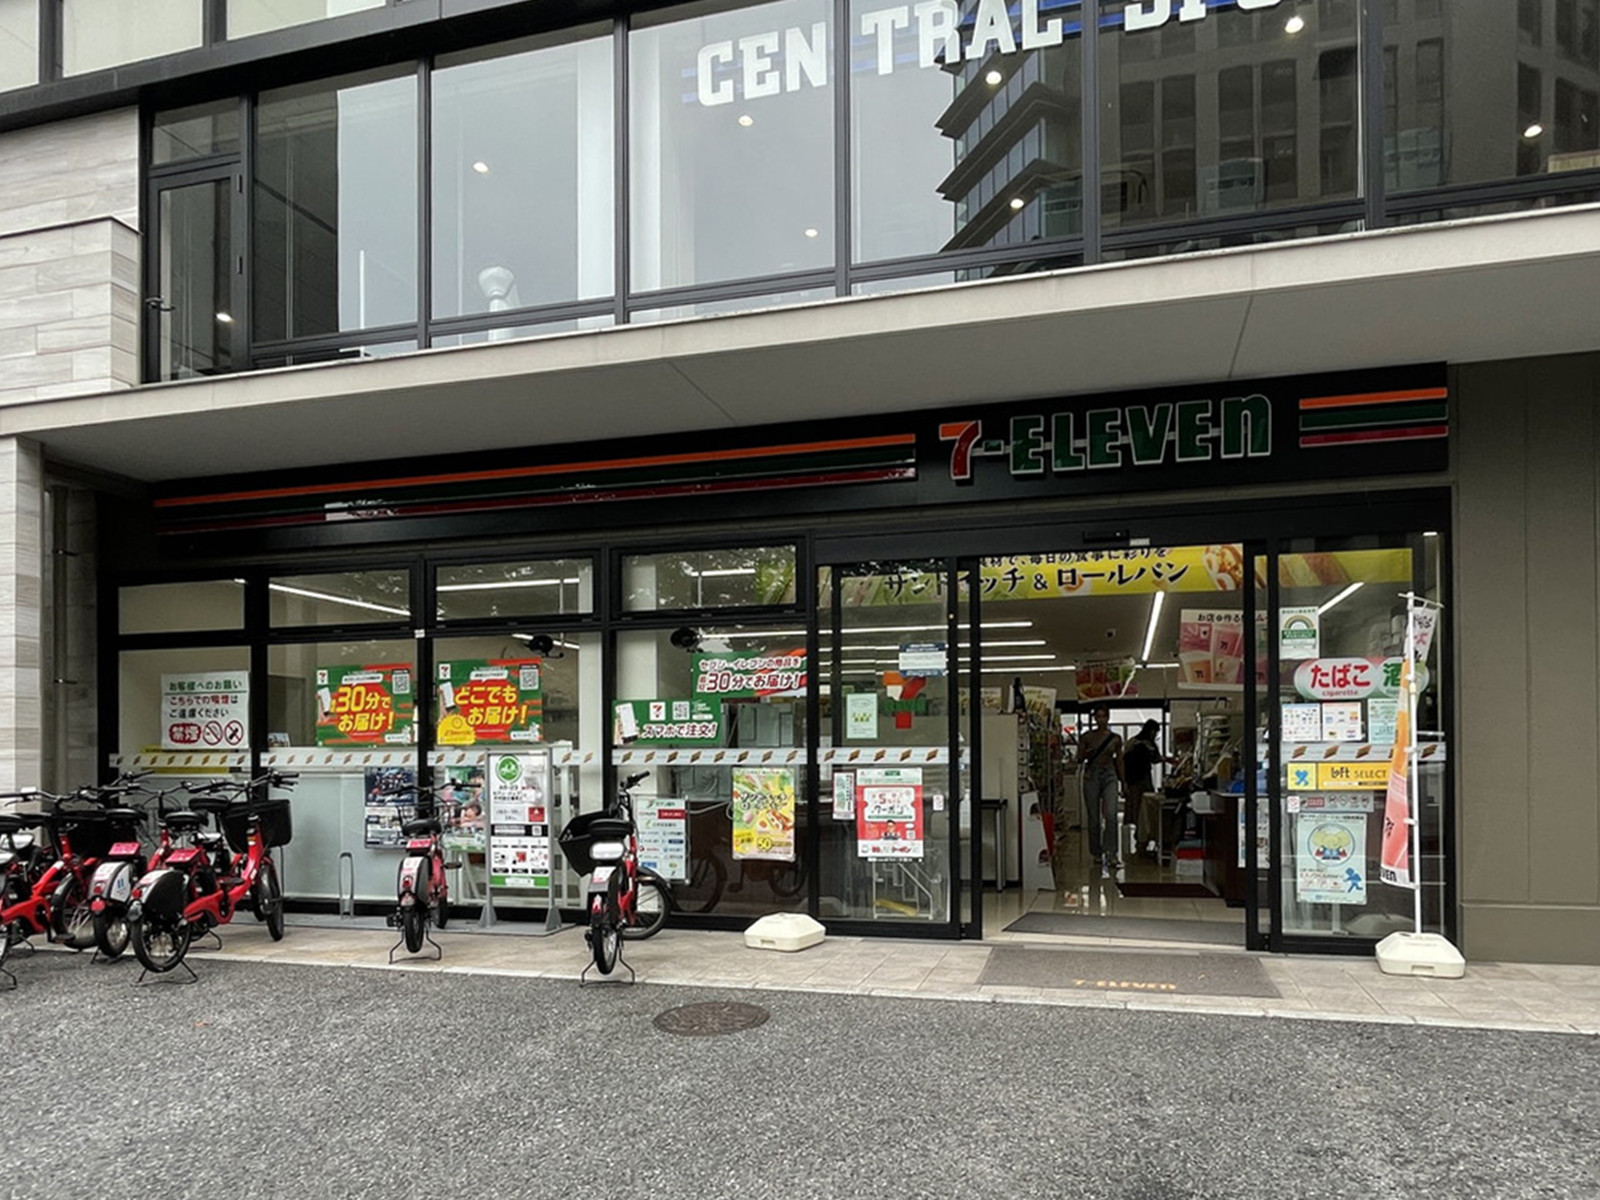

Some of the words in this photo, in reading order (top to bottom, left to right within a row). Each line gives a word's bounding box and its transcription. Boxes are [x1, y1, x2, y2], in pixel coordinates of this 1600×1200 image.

[698, 0, 1063, 107] CENTRAL
[1033, 573, 1049, 590] &
[1057, 563, 1189, 588] ロールパン
[170, 680, 242, 691] お客様へのお願い
[1311, 664, 1371, 688] たばこ
[170, 695, 239, 705] こちらでの喫煙は
[455, 685, 518, 704] どこでも
[338, 711, 394, 732] お届け!
[467, 705, 528, 725] お届け!
[642, 723, 717, 738] スマホで注文!
[1354, 769, 1387, 779] SELECT
